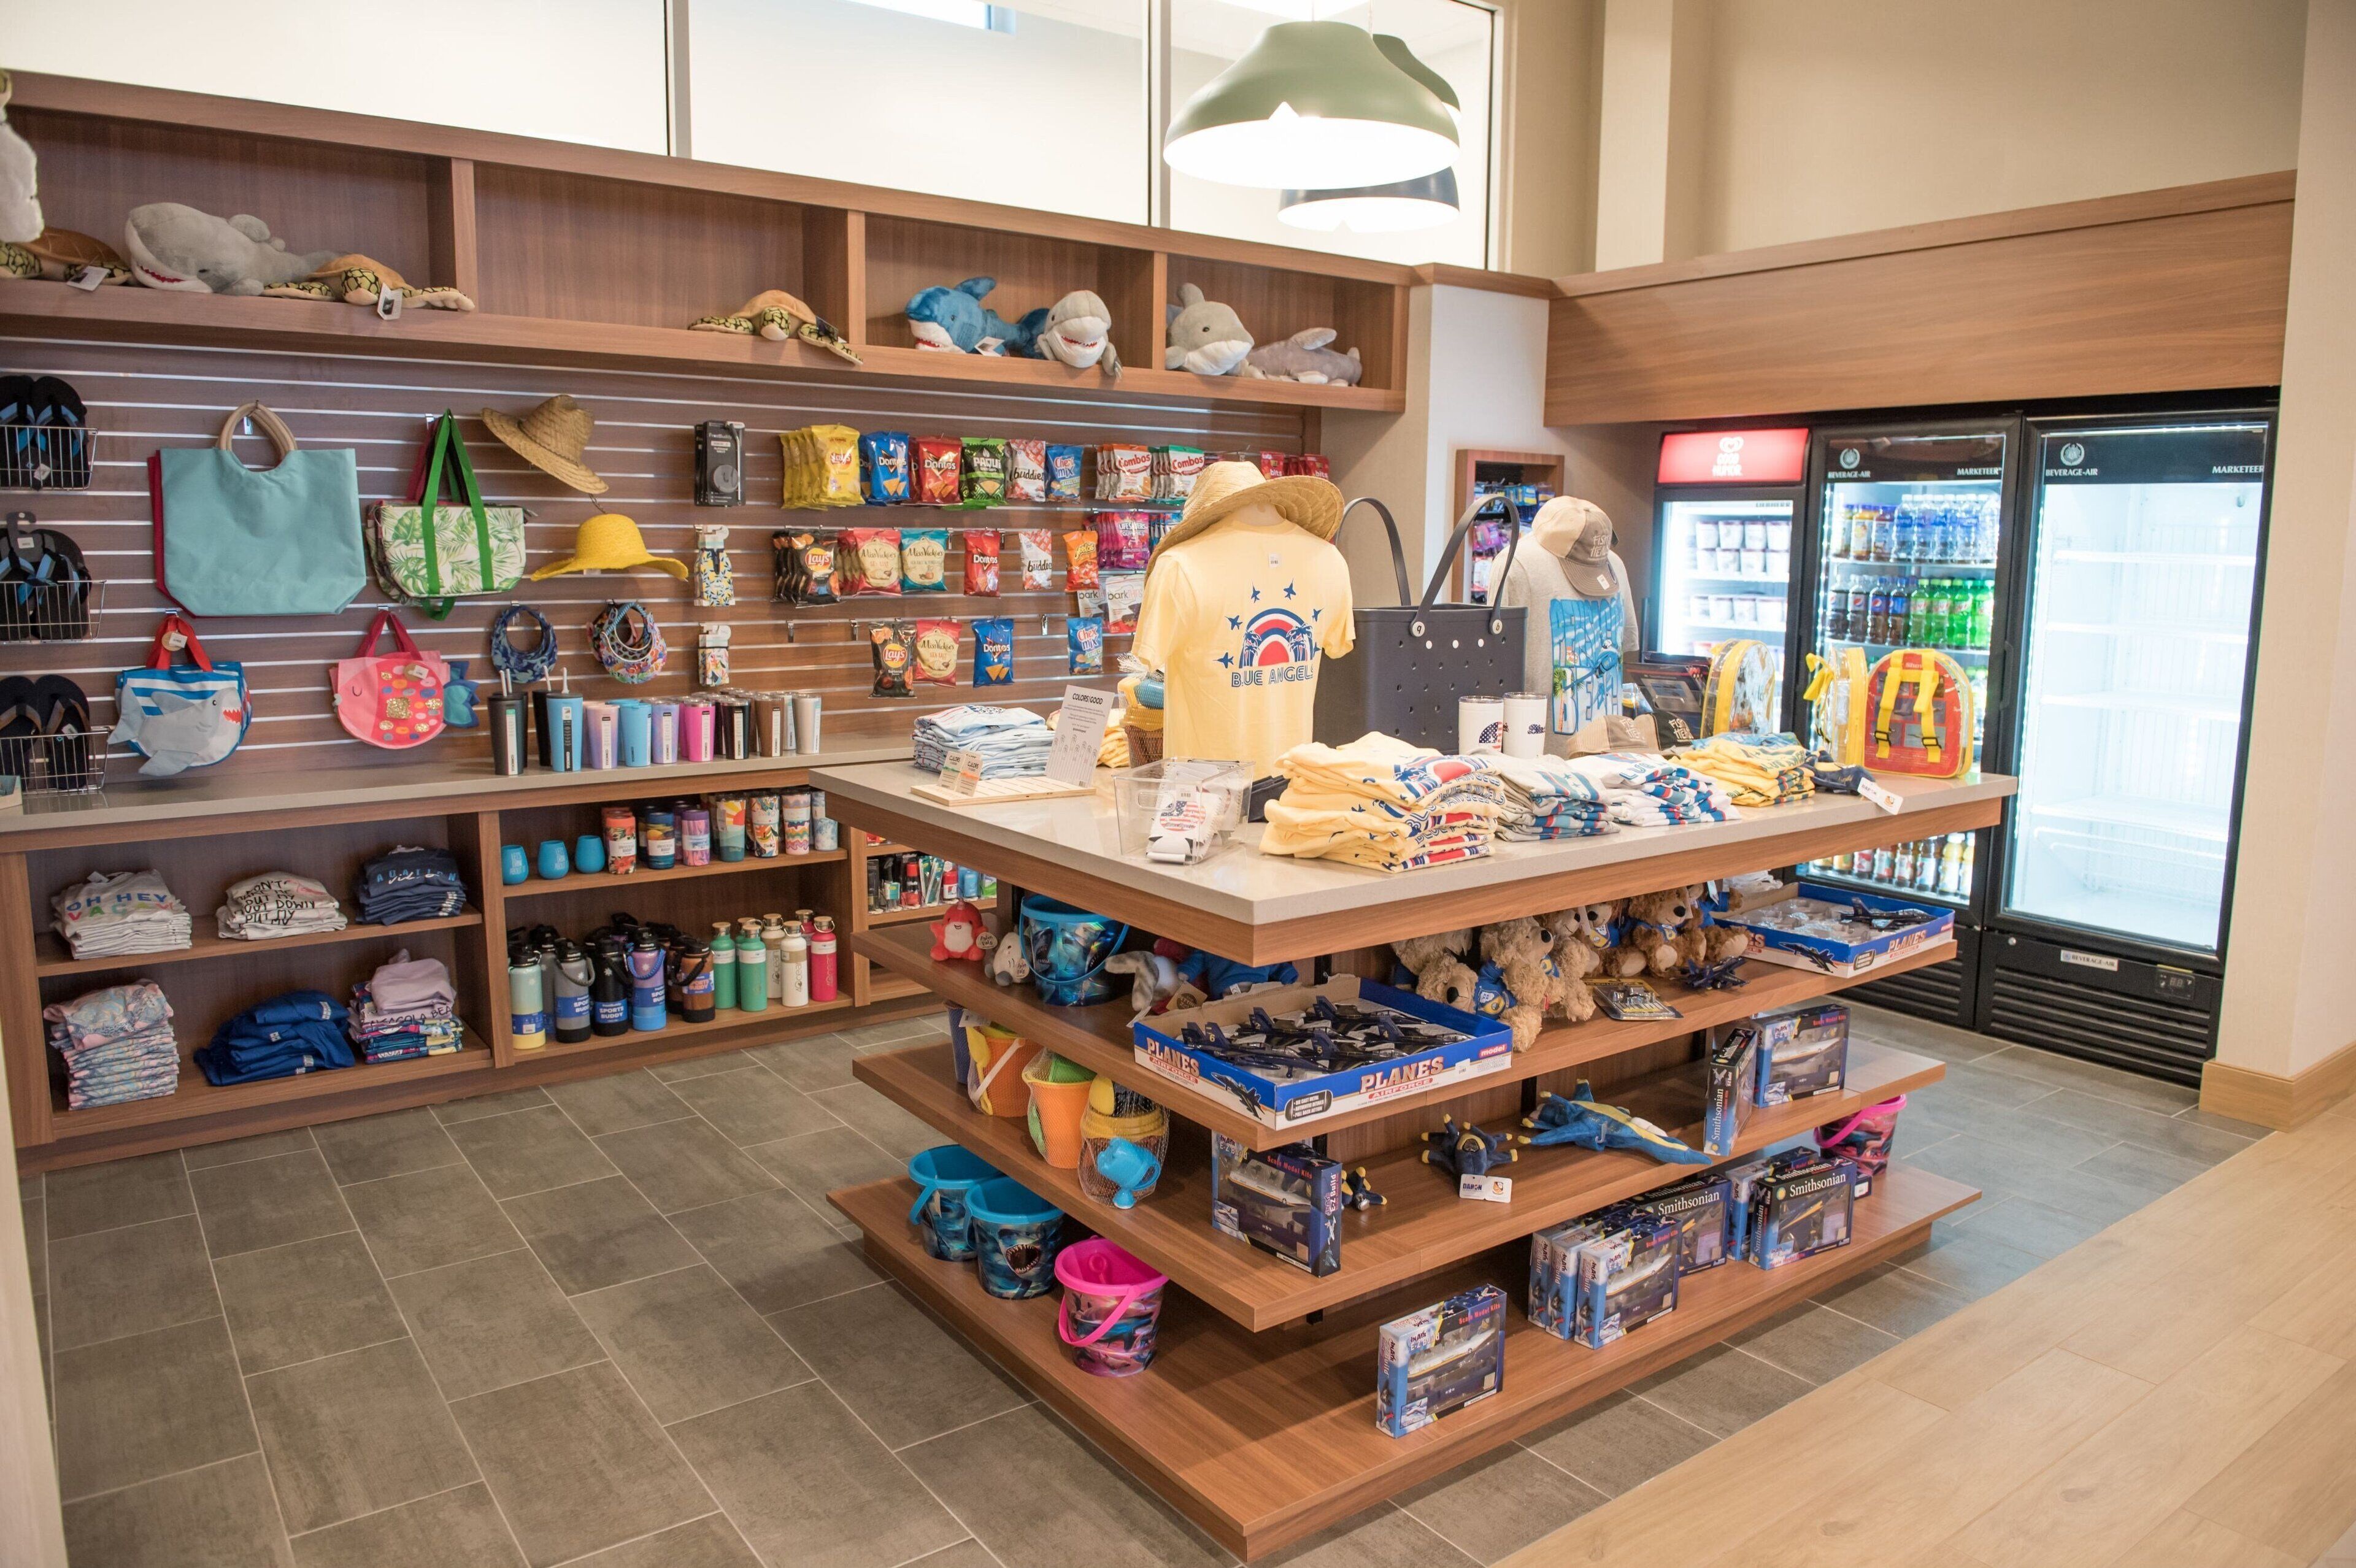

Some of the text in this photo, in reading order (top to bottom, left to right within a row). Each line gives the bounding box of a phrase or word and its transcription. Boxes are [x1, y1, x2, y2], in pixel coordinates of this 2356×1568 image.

[924, 459, 956, 471] Doritos
[973, 456, 1001, 469] PAQUI
[1055, 456, 1074, 467] Chex
[1118, 454, 1152, 469] Combos
[1171, 455, 1204, 470] Combos
[2045, 468, 2098, 477] BEVERAGE-AIR
[1077, 627, 1098, 640] Chex
[984, 644, 1011, 653] Doritos
[1231, 670, 1263, 688] BUE
[66, 893, 167, 911] OH HEY
[1887, 929, 1927, 953] PLANES
[1209, 1034, 1215, 1042] 6
[1146, 1036, 1201, 1078] PLANES
[1480, 1044, 1506, 1056] model
[1359, 1056, 1444, 1094] PLANES
[1371, 1078, 1431, 1099] AIRFORCE
[1711, 1088, 1724, 1142] Smithsonian
[1231, 1146, 1248, 1160] Build
[1283, 1161, 1301, 1175] Model
[1301, 1169, 1312, 1180] Kits
[1776, 1162, 1833, 1180] Smithsonian
[1646, 1180, 1705, 1198] Smithsonian
[1790, 1173, 1846, 1197] Smithsonian
[1658, 1191, 1720, 1216] Smithsonian
[1754, 1204, 1765, 1254] Smithsonian
[1474, 1309, 1490, 1318] Model
[1490, 1303, 1501, 1312] Kits
[1423, 1332, 1440, 1346] Build
